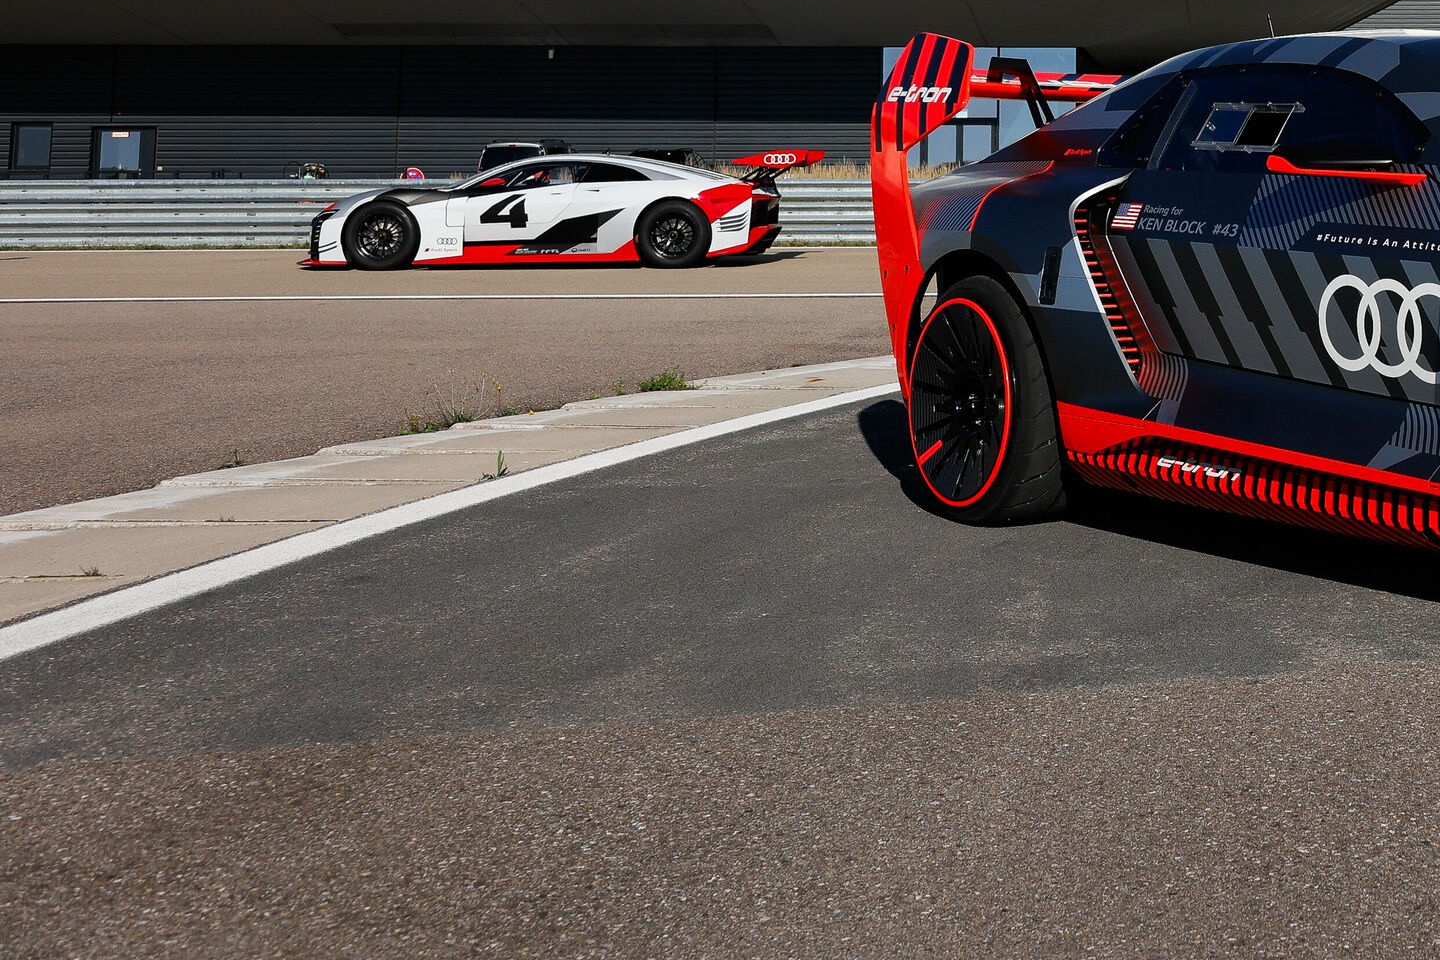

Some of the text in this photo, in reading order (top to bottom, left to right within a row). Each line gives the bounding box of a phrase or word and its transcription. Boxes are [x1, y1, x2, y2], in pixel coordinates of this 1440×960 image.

[887, 84, 952, 103] e-tron
[480, 194, 528, 228] 4
[1144, 204, 1184, 216] Racing for
[1137, 217, 1239, 237] KEN BLOCK #43
[1316, 233, 1363, 245] #Future
[1367, 236, 1378, 246] Is
[1382, 238, 1398, 248] An
[1157, 455, 1242, 481] e-tron
